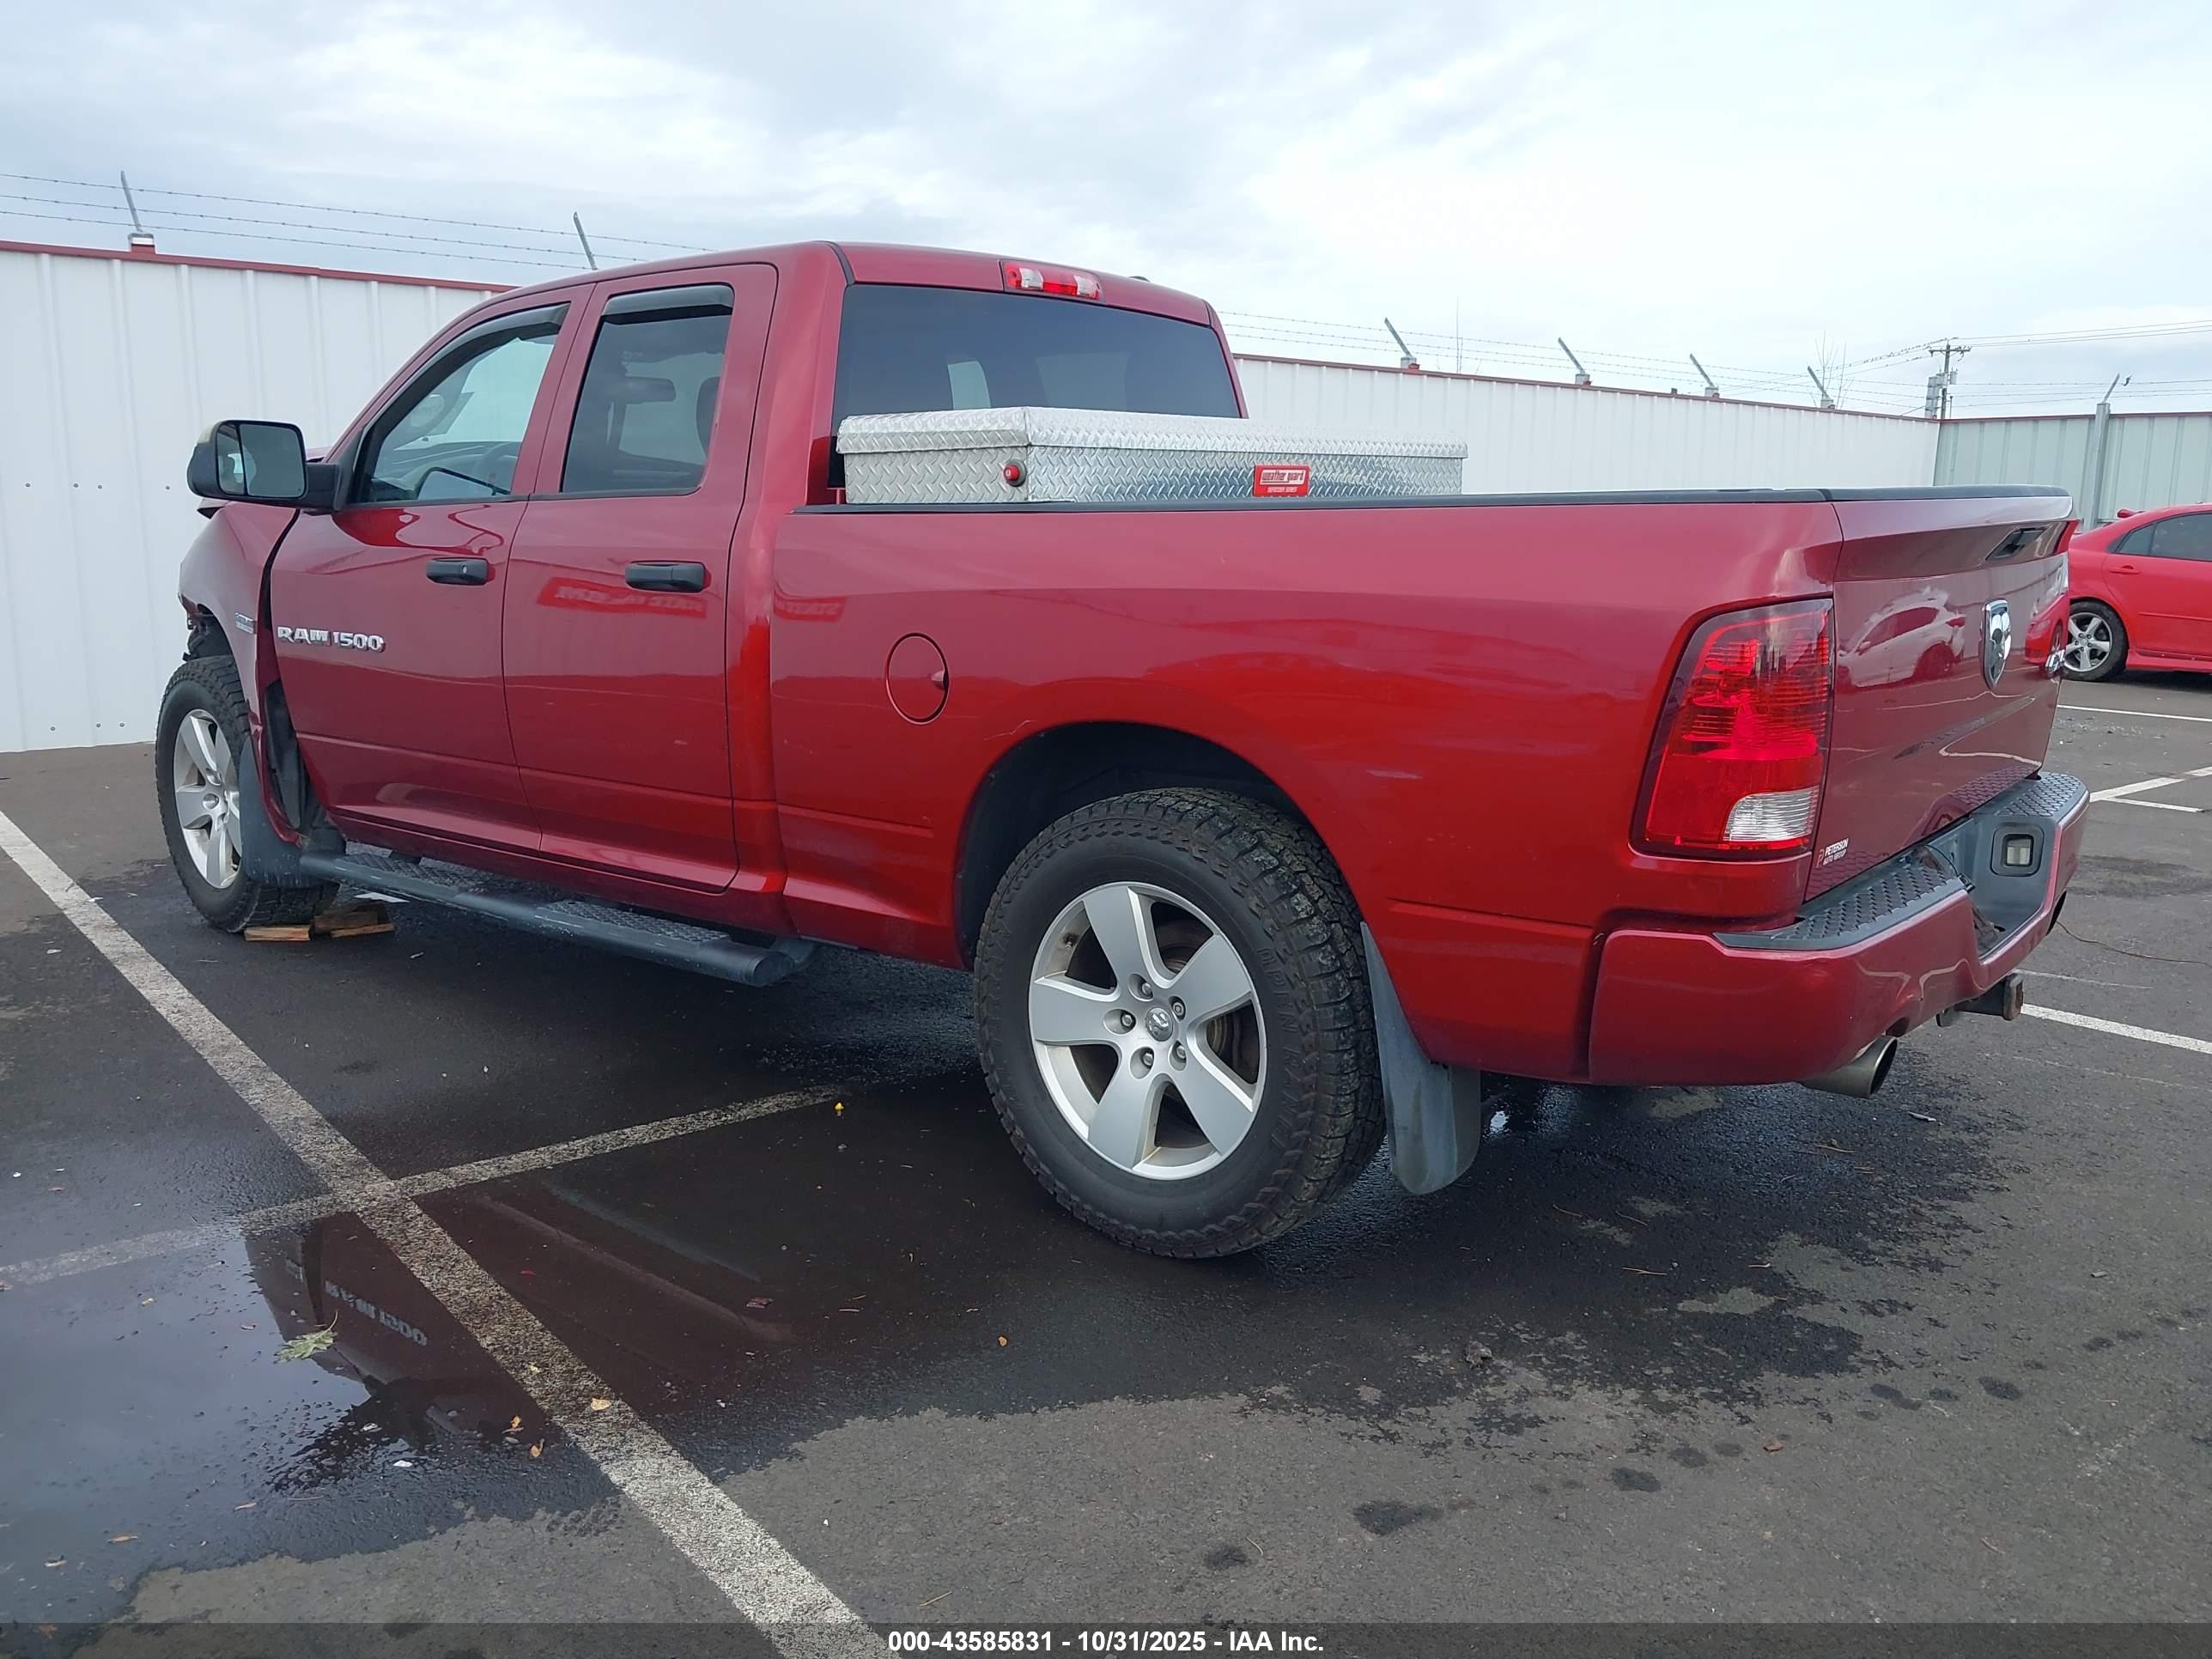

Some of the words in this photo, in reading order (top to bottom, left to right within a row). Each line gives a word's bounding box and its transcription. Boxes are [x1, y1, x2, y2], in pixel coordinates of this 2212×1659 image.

[277, 626, 329, 645] RAM
[332, 631, 385, 651] 1500
[1825, 837, 1850, 856] PETERSON
